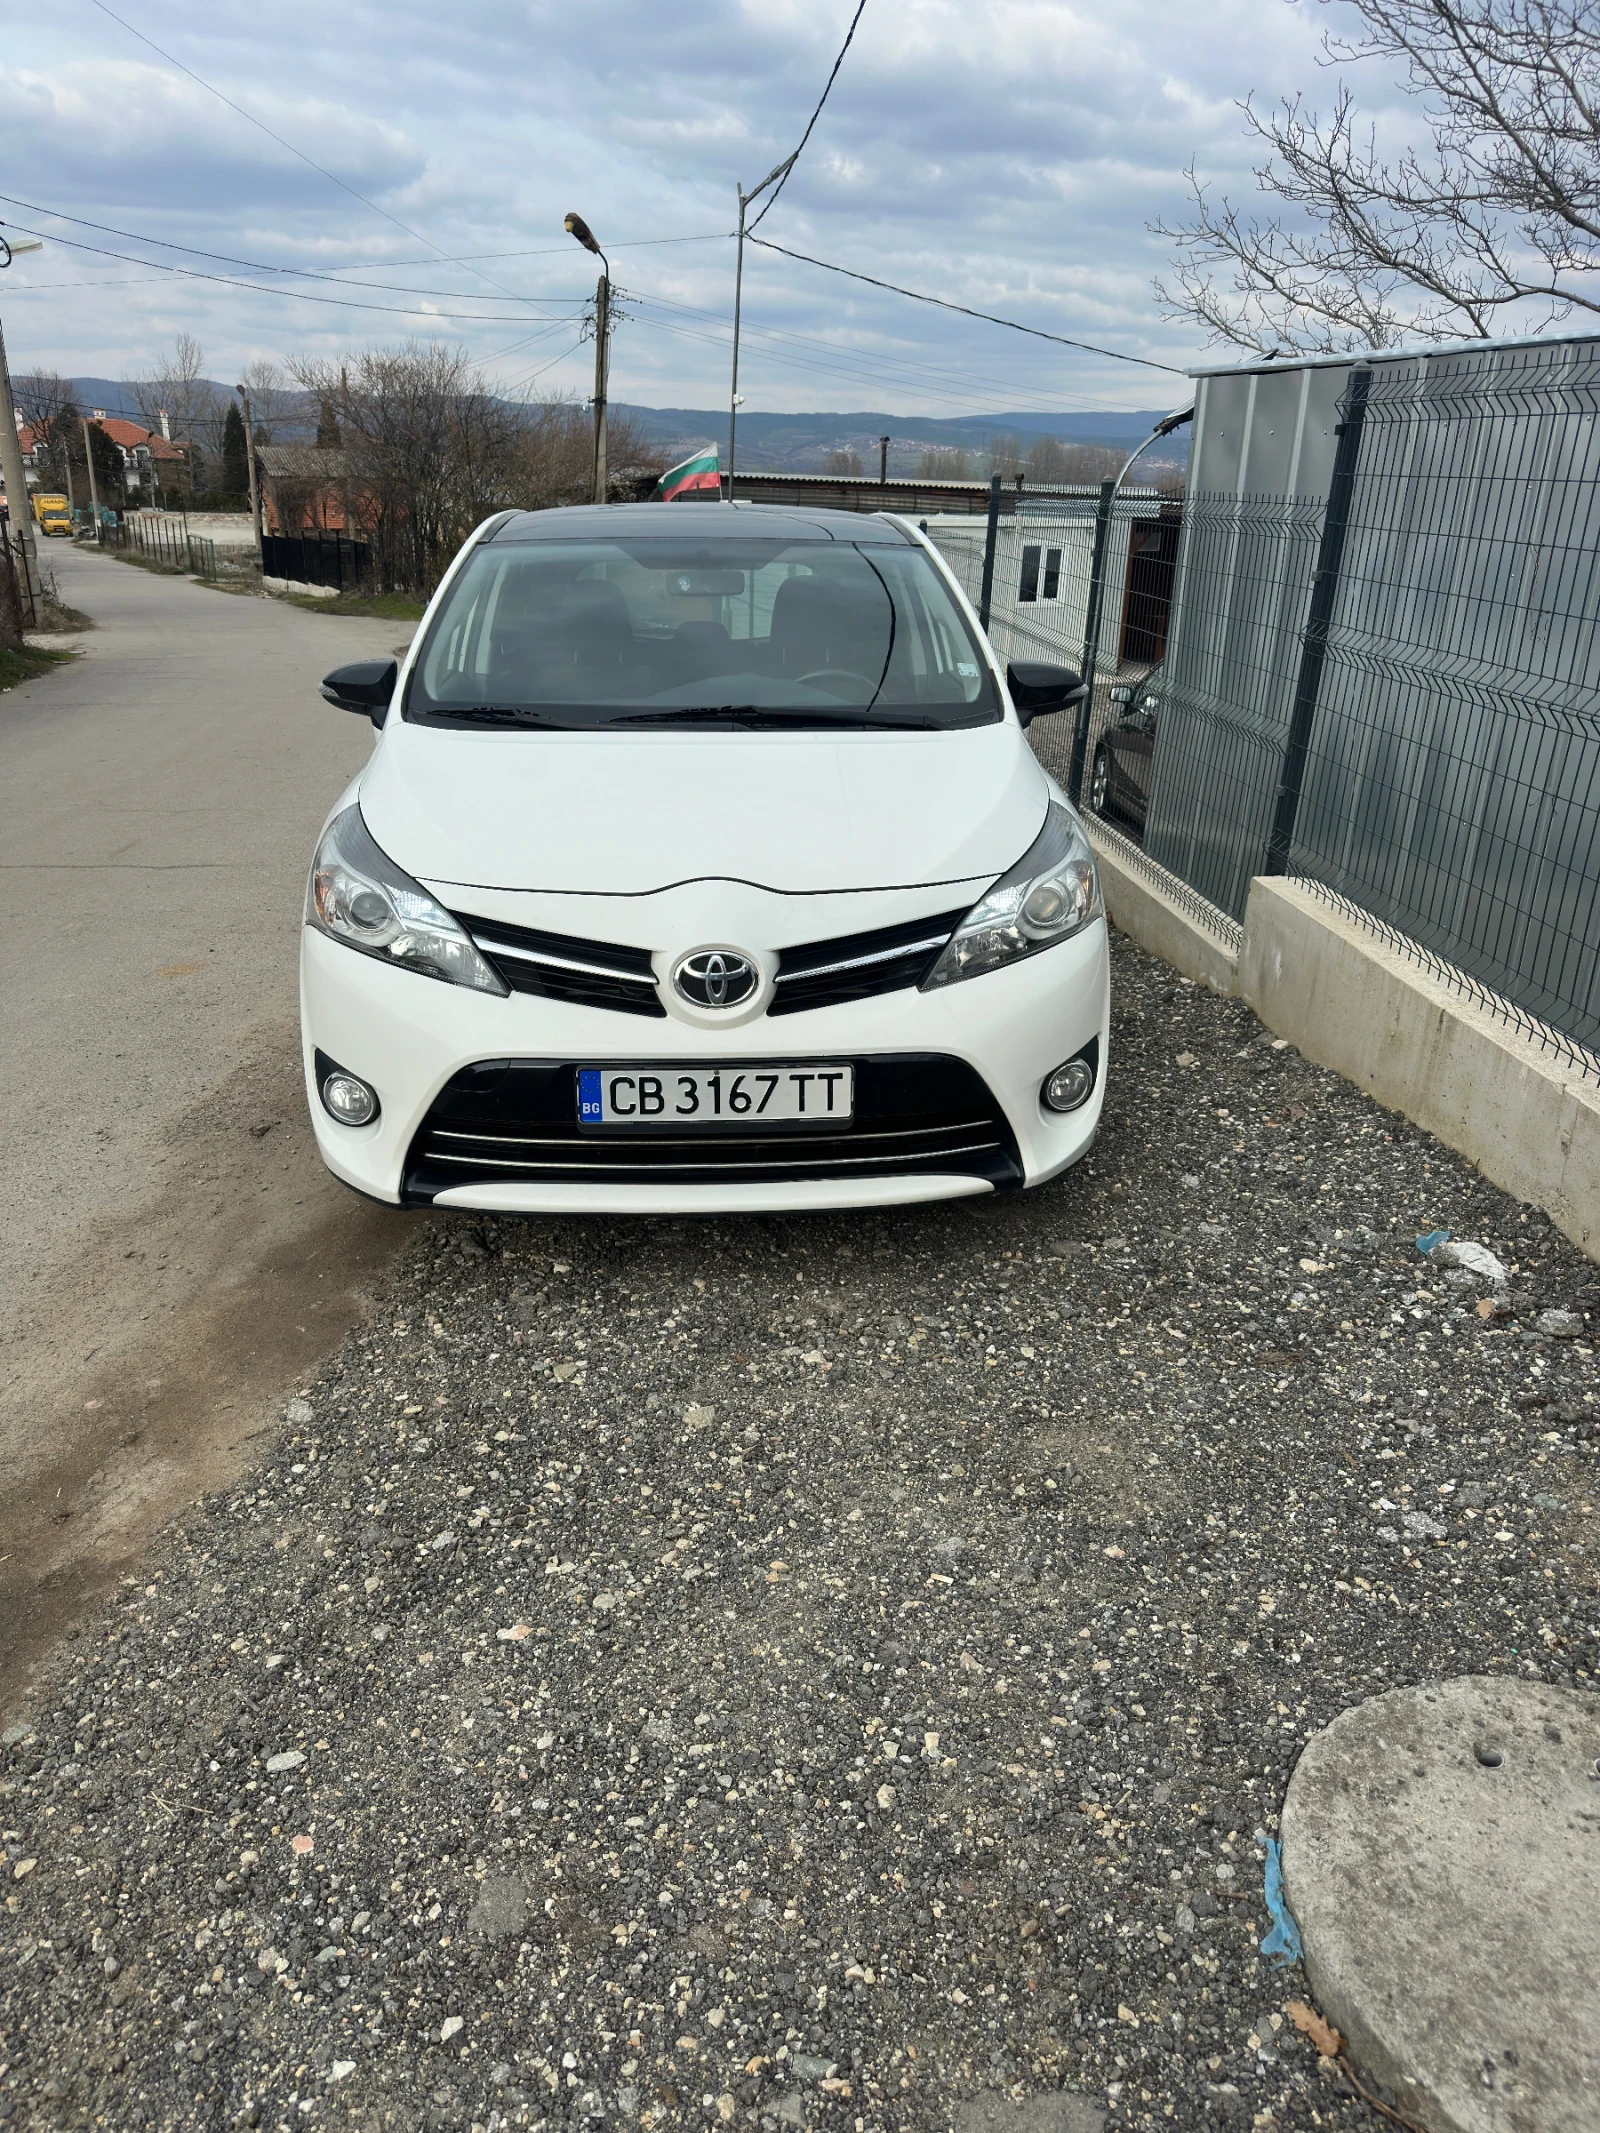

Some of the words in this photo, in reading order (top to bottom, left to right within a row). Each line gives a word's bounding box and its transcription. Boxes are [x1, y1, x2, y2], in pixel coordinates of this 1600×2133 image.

[609, 1076, 665, 1115] CB
[675, 1075, 779, 1115] 3167
[789, 1072, 844, 1112] TT
[582, 1102, 600, 1114] BG
